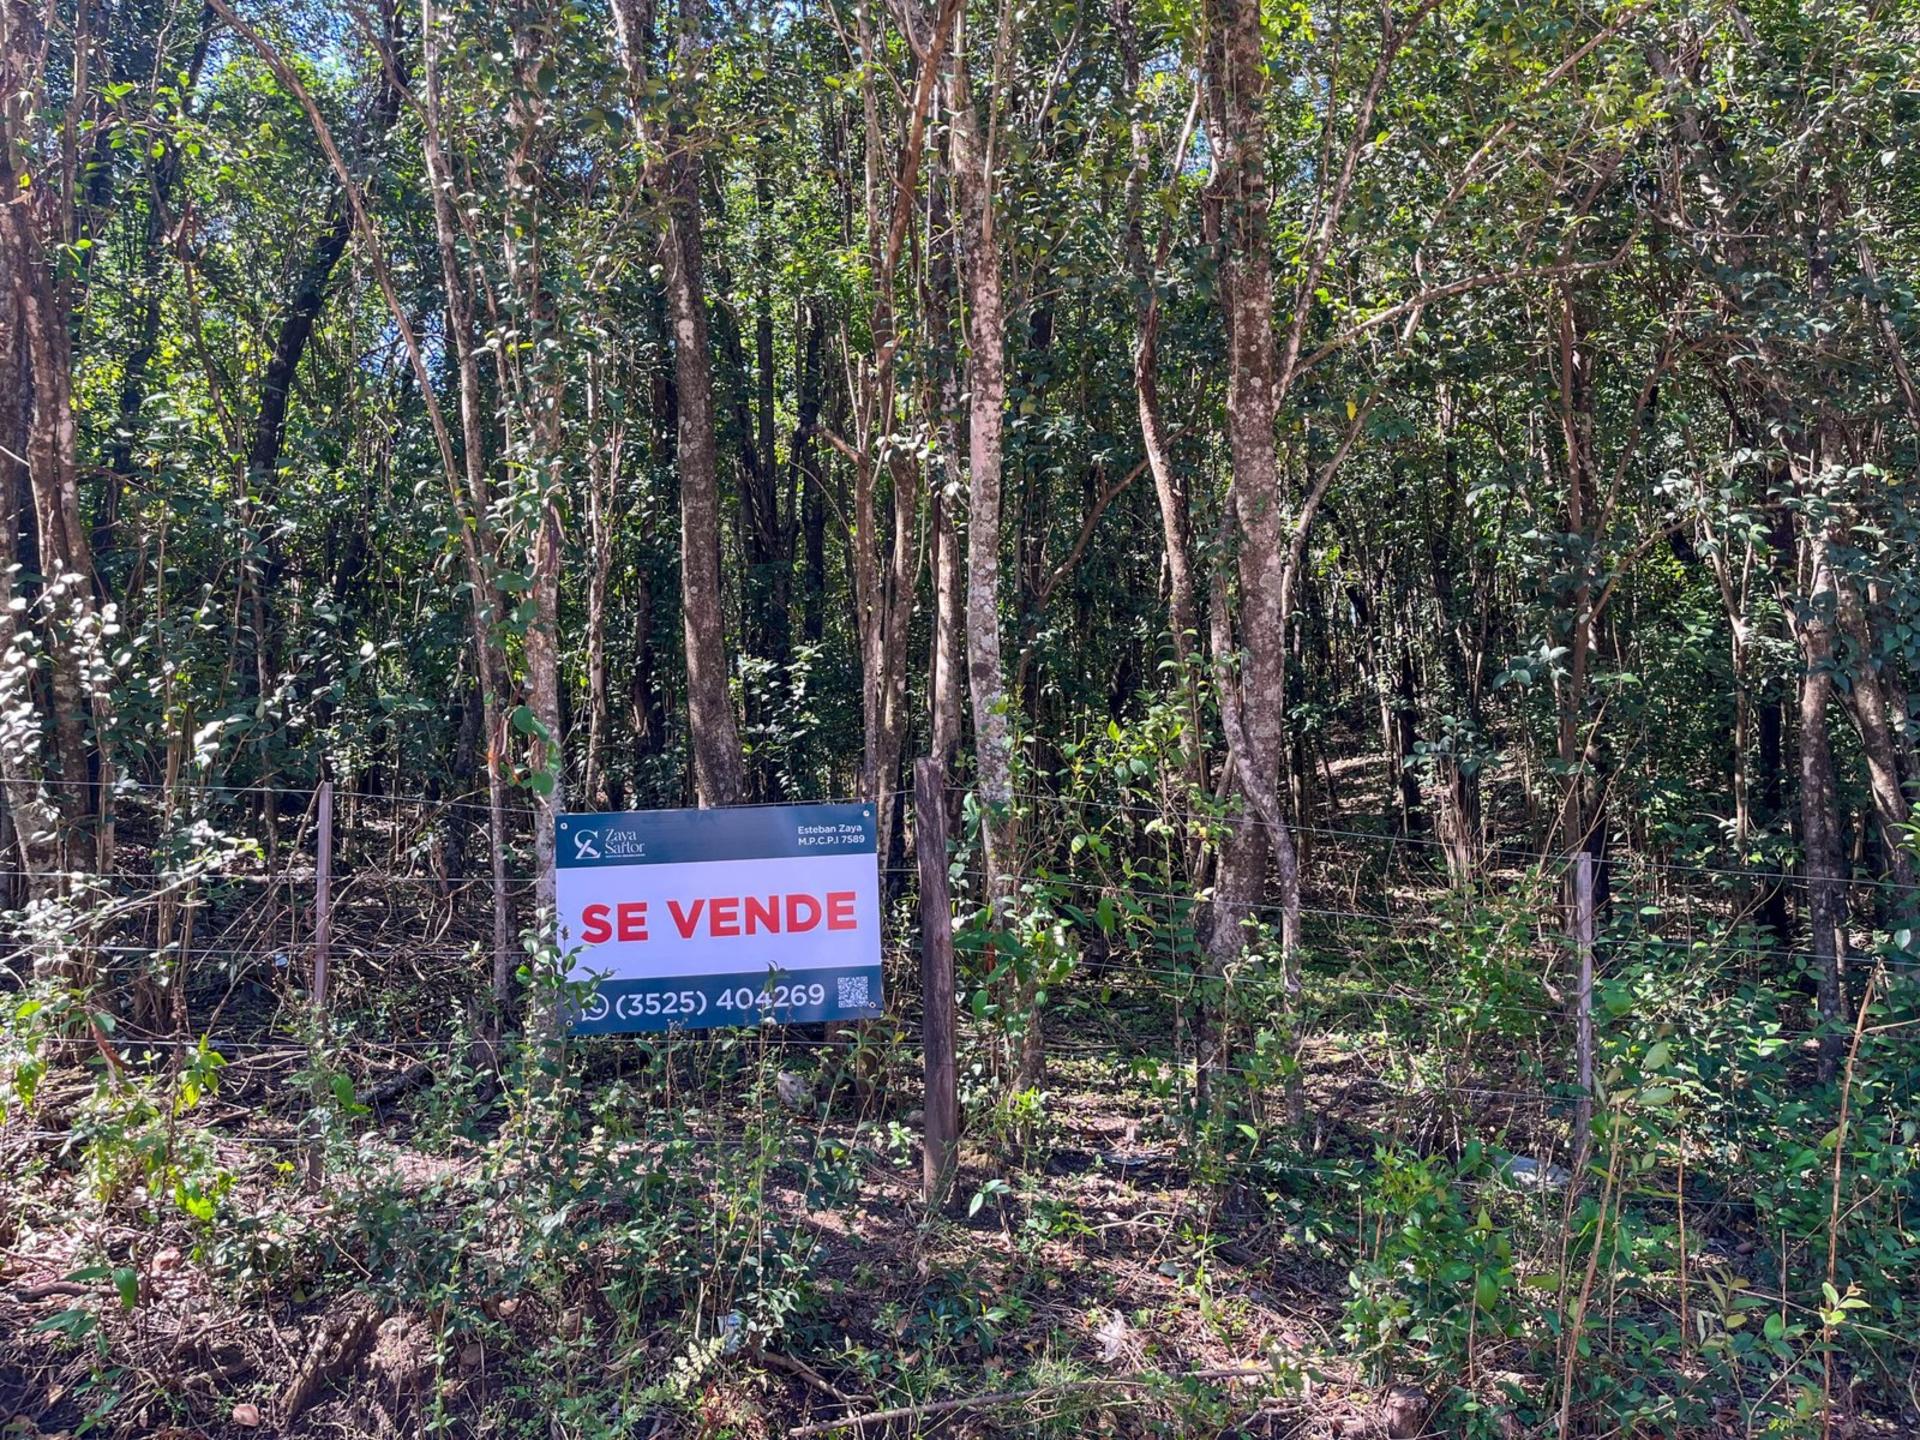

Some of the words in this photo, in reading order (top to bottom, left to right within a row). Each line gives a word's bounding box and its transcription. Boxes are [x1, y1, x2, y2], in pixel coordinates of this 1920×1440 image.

[605, 829, 637, 842] Zaya
[798, 825, 837, 835] Esteban
[838, 824, 863, 834] Zaya
[841, 835, 866, 844] 7589
[581, 902, 649, 943] SE
[667, 891, 857, 939] VENDE
[615, 991, 707, 1019] (3525)
[715, 983, 826, 1011] 404269
